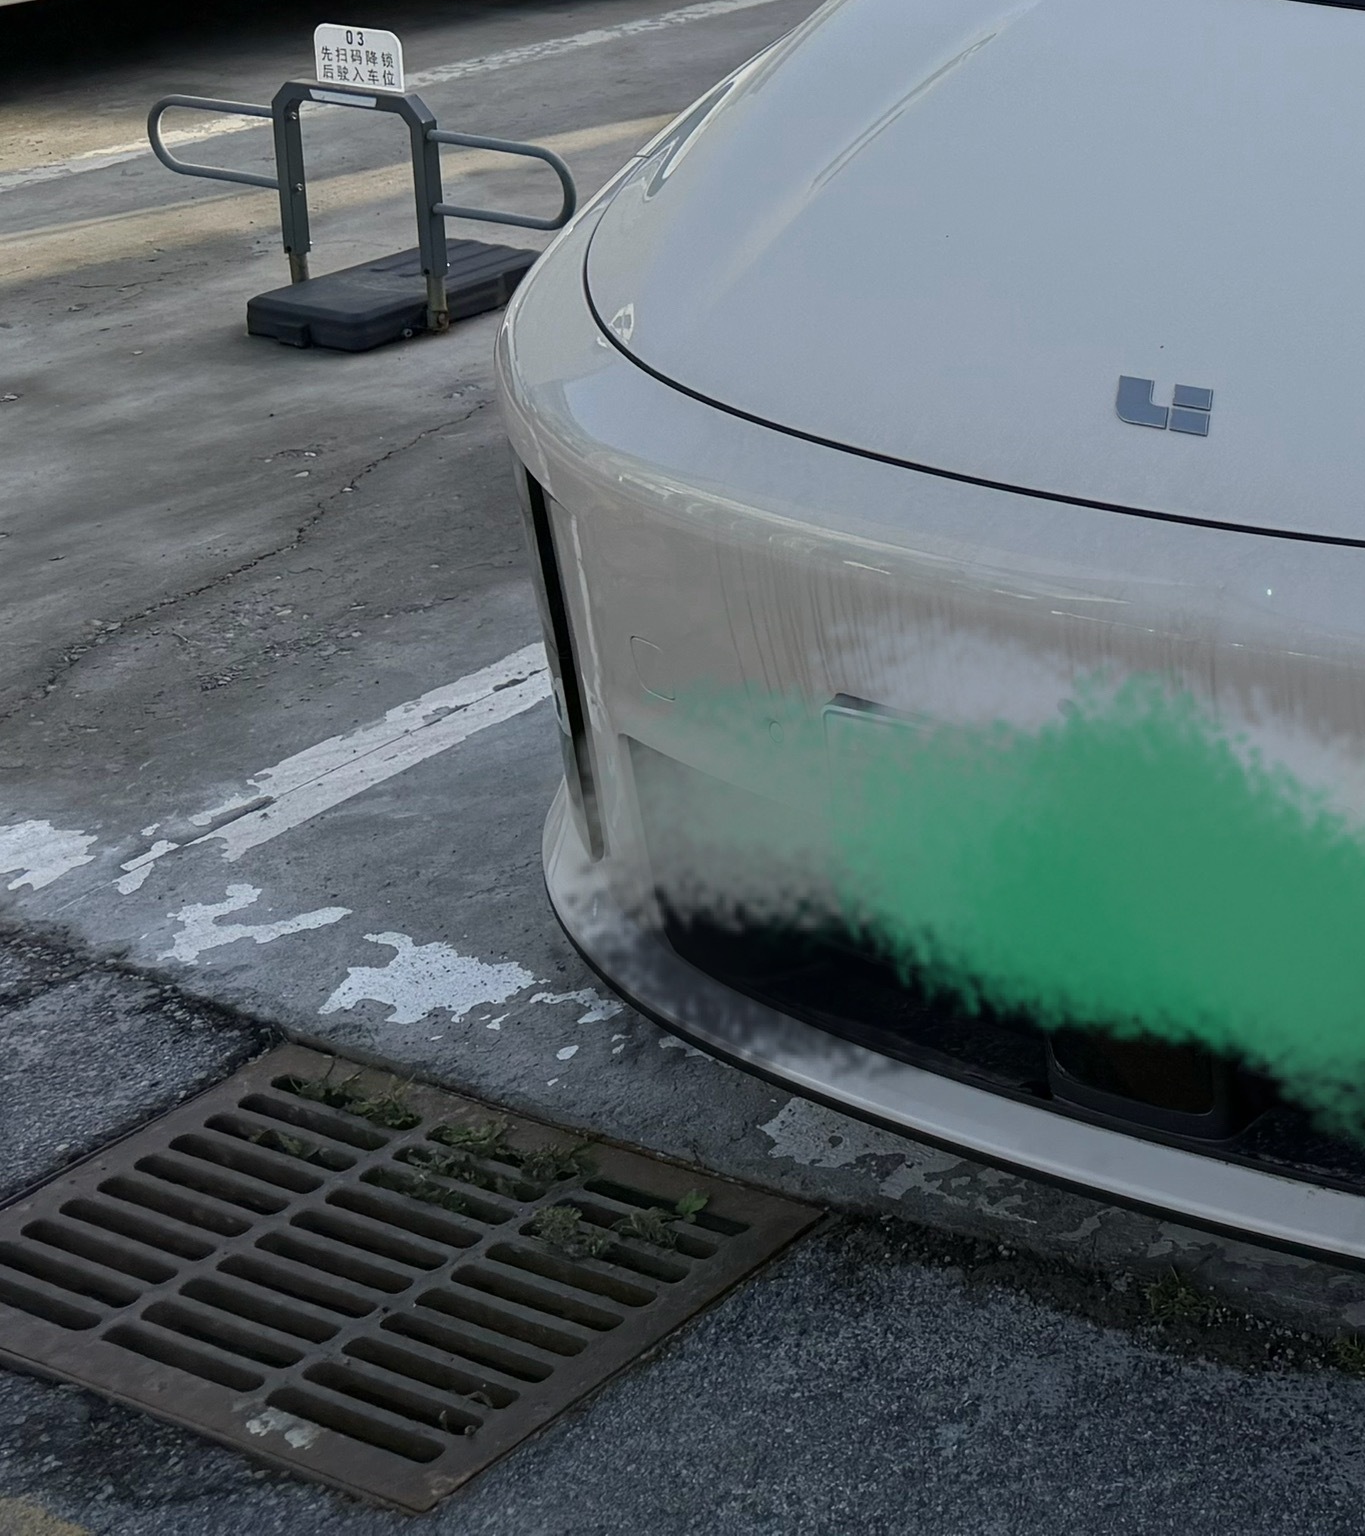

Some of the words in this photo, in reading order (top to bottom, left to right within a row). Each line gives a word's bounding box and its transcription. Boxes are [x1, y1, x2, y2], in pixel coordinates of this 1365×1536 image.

[345, 30, 364, 46] 03
[321, 46, 394, 69] 先扫码降锁
[322, 64, 395, 86] 后驶入车位
